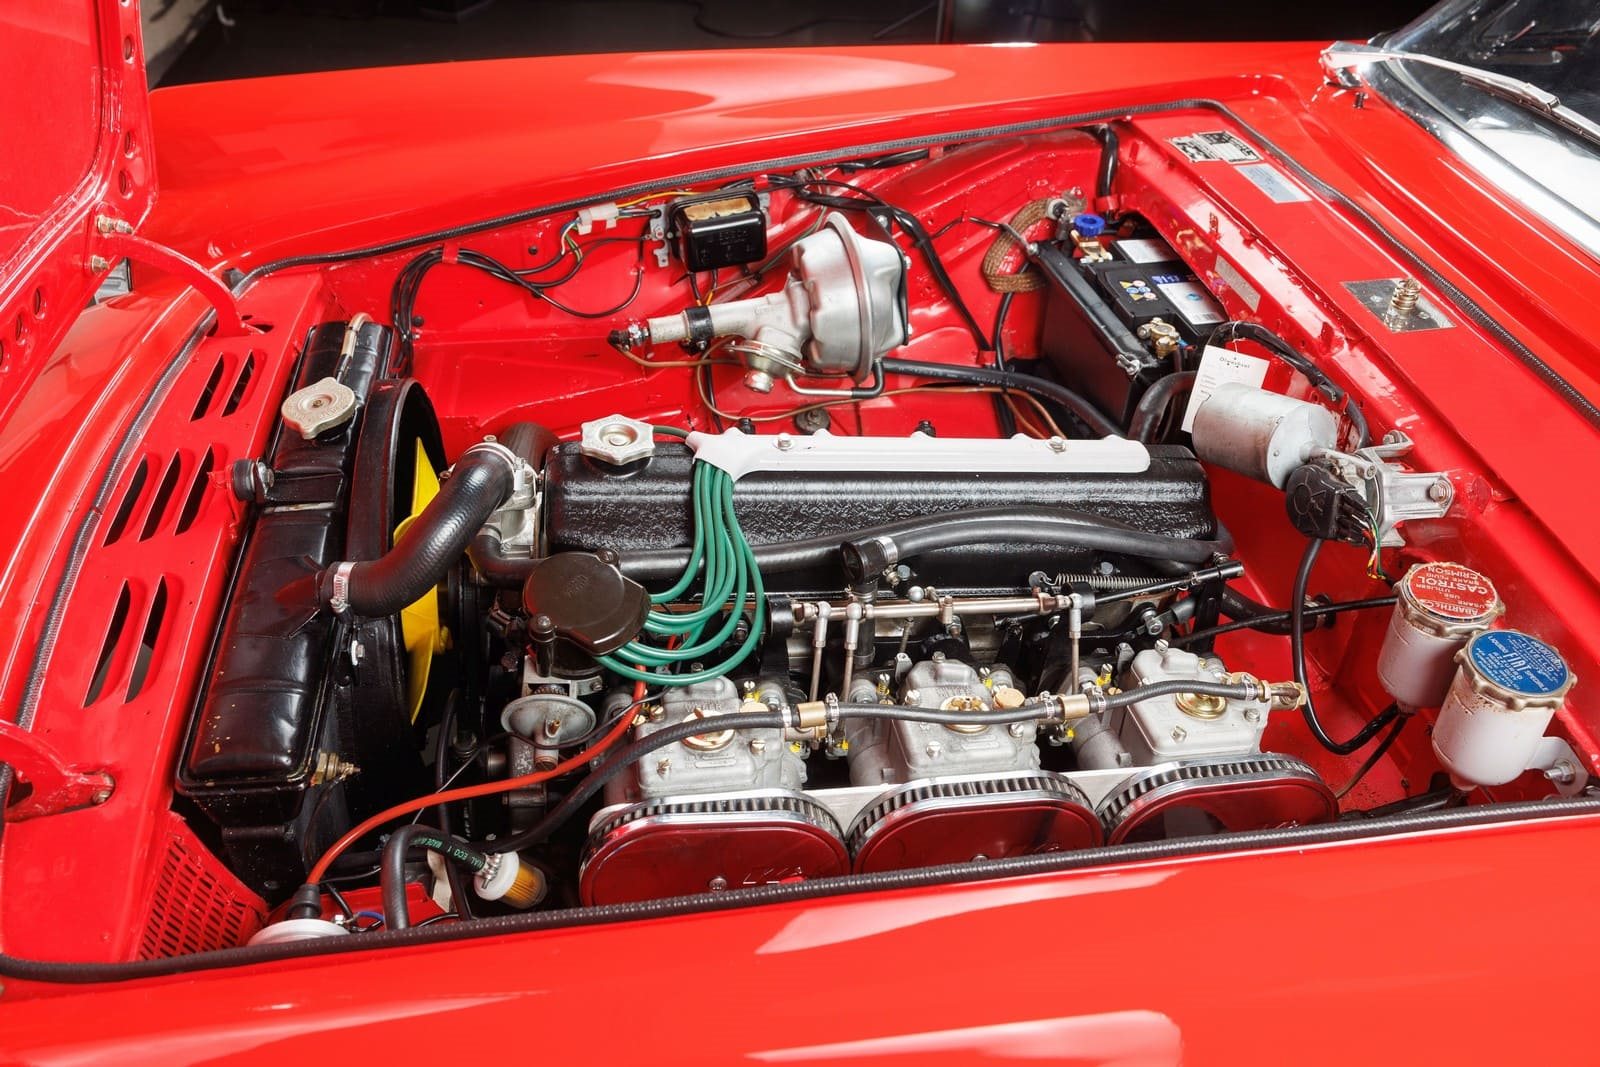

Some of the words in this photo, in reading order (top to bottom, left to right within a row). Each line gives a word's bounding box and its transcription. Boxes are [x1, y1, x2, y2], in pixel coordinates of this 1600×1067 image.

[1427, 565, 1479, 580] CRIMSON
[1453, 577, 1480, 586] BRAKE
[1417, 575, 1488, 595] CASTROL
[1491, 651, 1523, 680] AZZURRO
[1502, 650, 1531, 671] FIAT
[1520, 642, 1554, 672] LIVELLO
